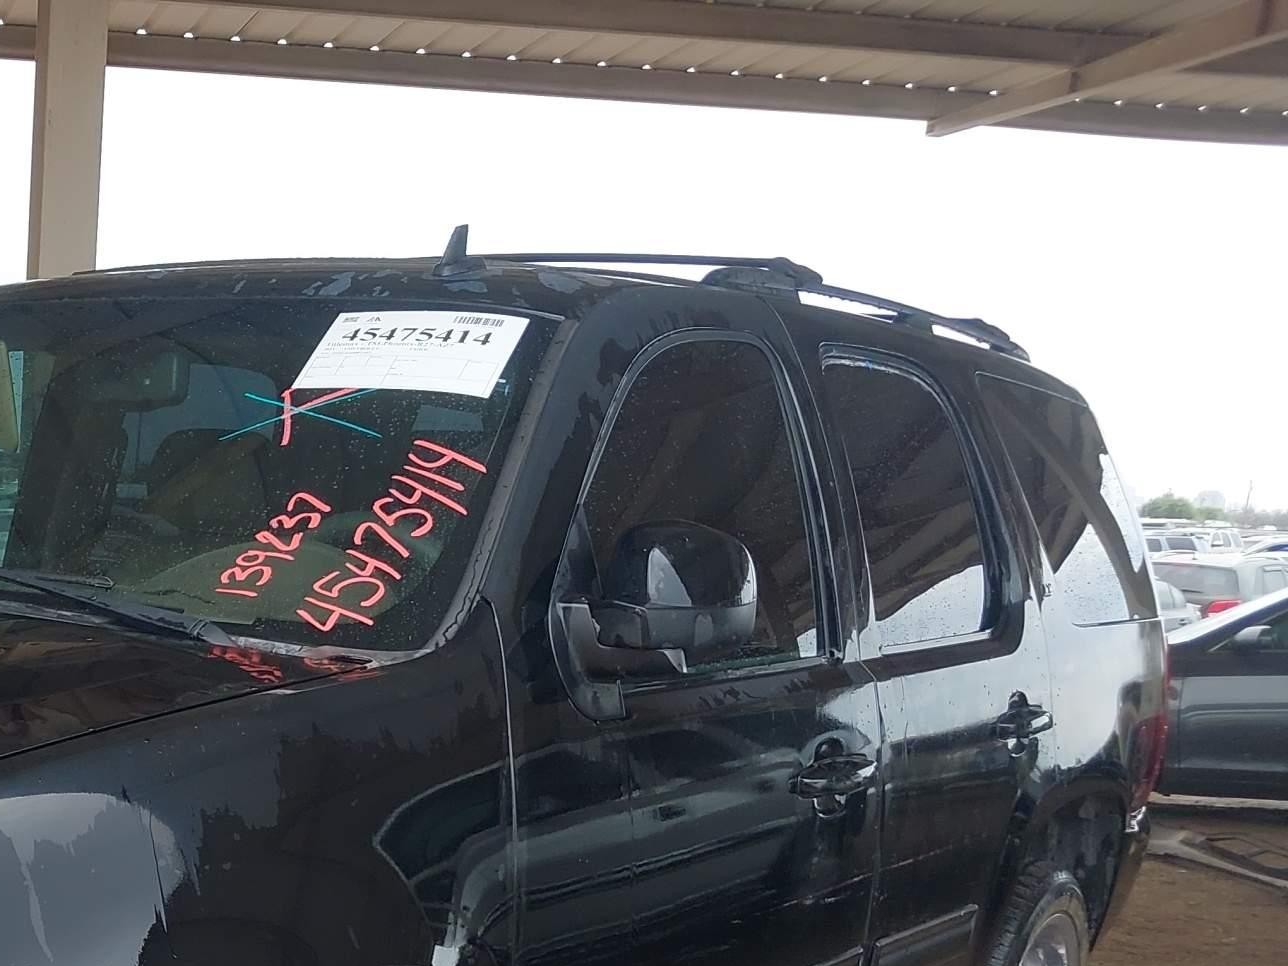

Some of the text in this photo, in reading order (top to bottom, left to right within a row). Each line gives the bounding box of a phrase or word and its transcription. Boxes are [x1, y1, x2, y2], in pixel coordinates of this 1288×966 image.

[341, 326, 494, 347] 45475414
[215, 491, 332, 598] 139237
[295, 439, 488, 632] 45475414
